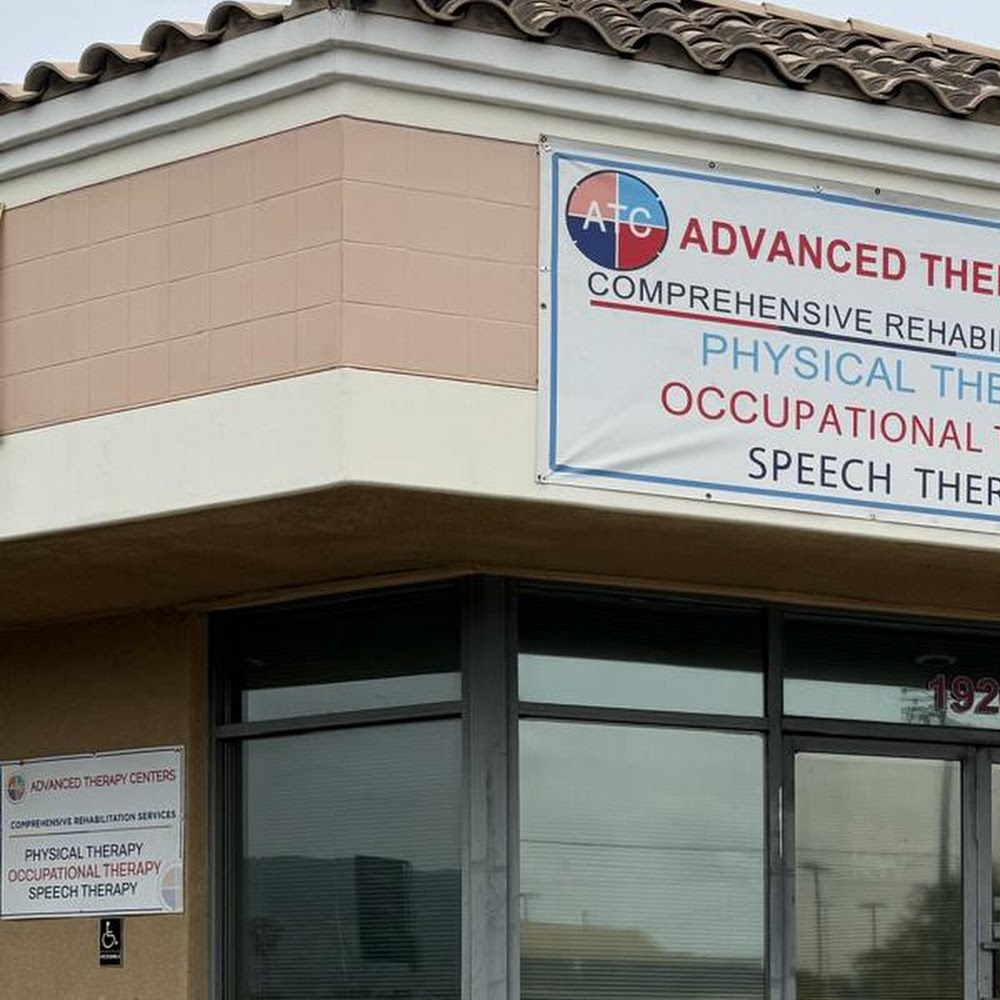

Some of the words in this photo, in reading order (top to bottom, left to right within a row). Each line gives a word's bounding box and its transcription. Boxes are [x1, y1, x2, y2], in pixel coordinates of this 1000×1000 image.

[583, 199, 652, 238] ATC
[679, 217, 907, 281] ADVANCED
[587, 271, 873, 334] COMPREHENSIVE
[702, 332, 915, 393] PHYSICAL
[661, 381, 983, 453] OCCUPATIONAL
[748, 446, 892, 495] SPEECH
[30, 776, 82, 793] ADVANCED
[83, 772, 128, 787] THERAPY
[129, 769, 176, 784] CENTERS
[11, 817, 73, 829] COMPREHENSIVE
[74, 812, 136, 824] REHABILITATION
[137, 810, 176, 821] SERVICES
[8, 863, 101, 882] OCCUPATIONAL
[103, 860, 162, 878] THERAPY
[25, 846, 84, 861] PHYSICAL
[87, 842, 144, 858] THERAPY
[28, 885, 79, 900] SPEECH
[81, 881, 138, 897] THERAPY
